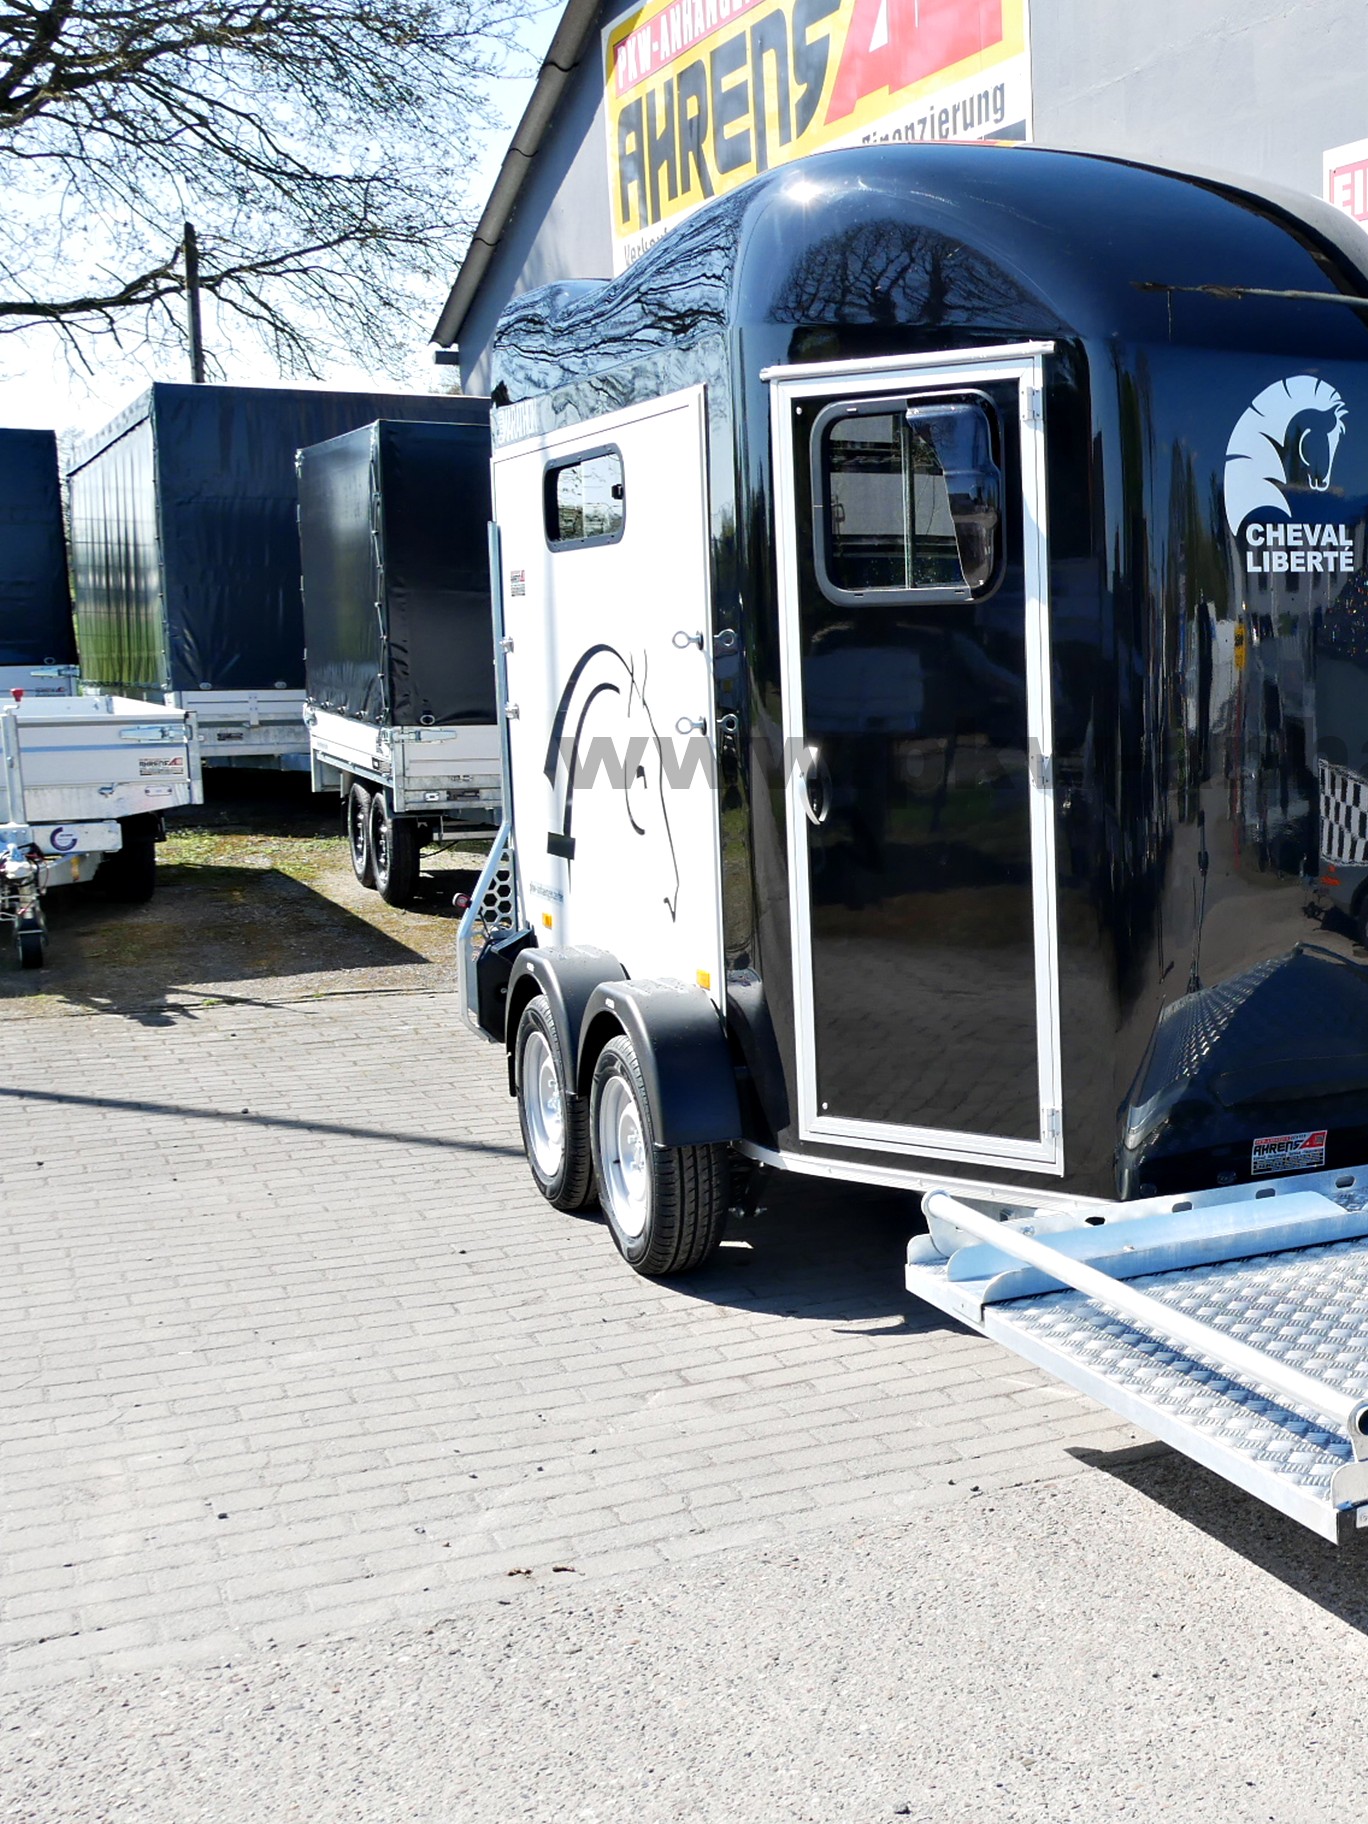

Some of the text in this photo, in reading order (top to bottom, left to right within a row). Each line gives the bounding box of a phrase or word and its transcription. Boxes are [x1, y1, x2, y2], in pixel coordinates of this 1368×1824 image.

[618, 0, 841, 231] AHRENS
[1246, 523, 1354, 547] CHEVAL
[1246, 546, 1354, 573] LIBERTÉ
[1253, 1140, 1305, 1157] AHRENS
